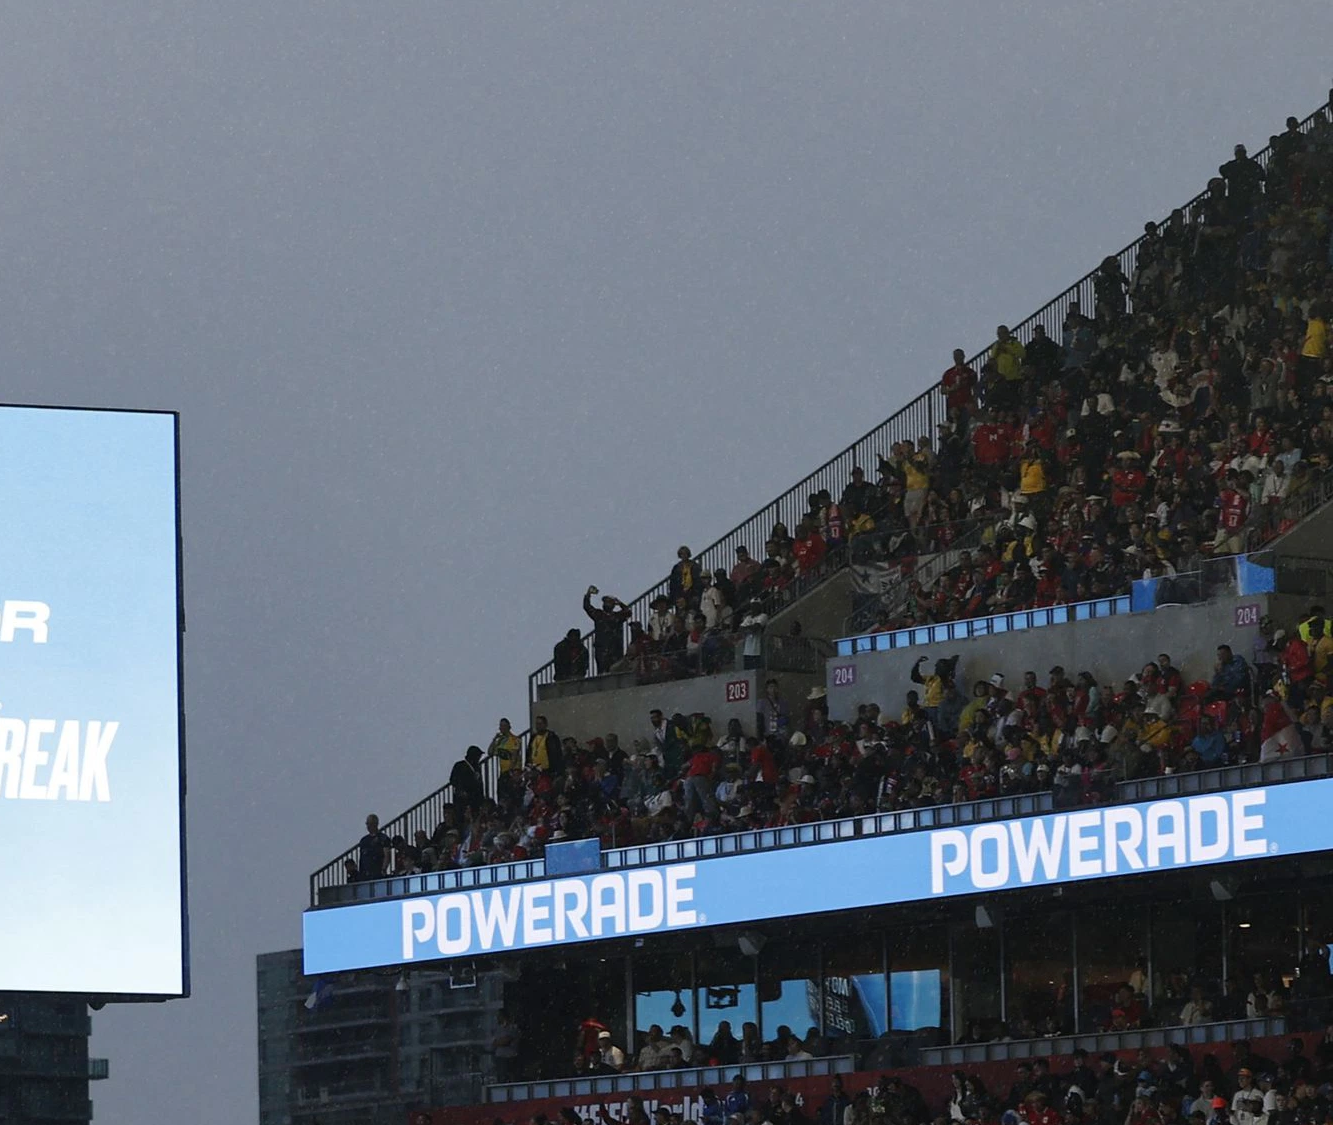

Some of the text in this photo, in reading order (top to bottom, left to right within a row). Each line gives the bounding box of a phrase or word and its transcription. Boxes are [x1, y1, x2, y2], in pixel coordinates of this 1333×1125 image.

[1236, 607, 1257, 625] 204
[835, 667, 853, 685] 204
[728, 683, 746, 700] 203
[931, 789, 1269, 895] POWERADE
[401, 862, 698, 960] POWERADE
